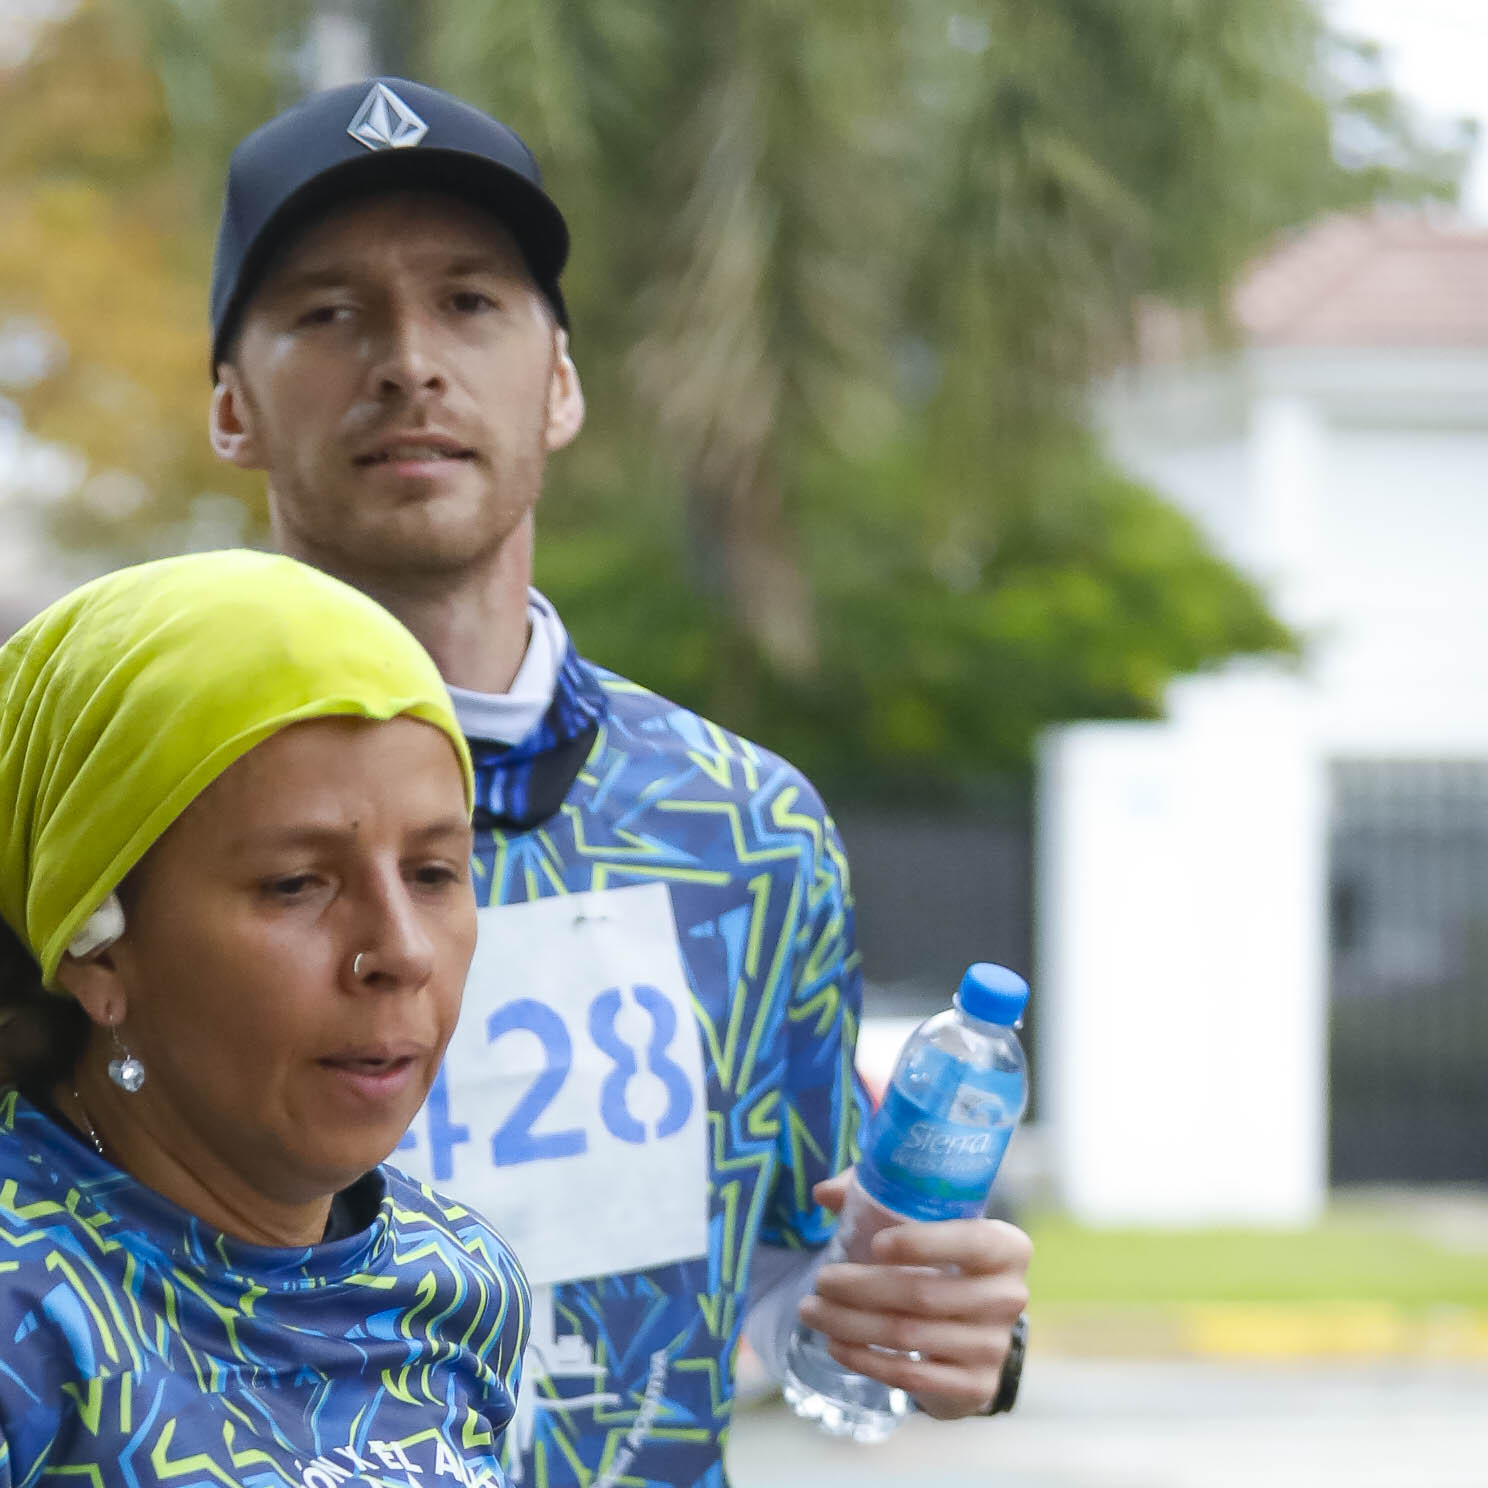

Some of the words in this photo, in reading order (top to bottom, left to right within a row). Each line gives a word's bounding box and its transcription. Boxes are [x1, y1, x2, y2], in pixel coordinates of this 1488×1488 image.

[398, 984, 694, 1182] 428
[333, 1445, 380, 1472] X
[367, 1440, 424, 1474] EL
